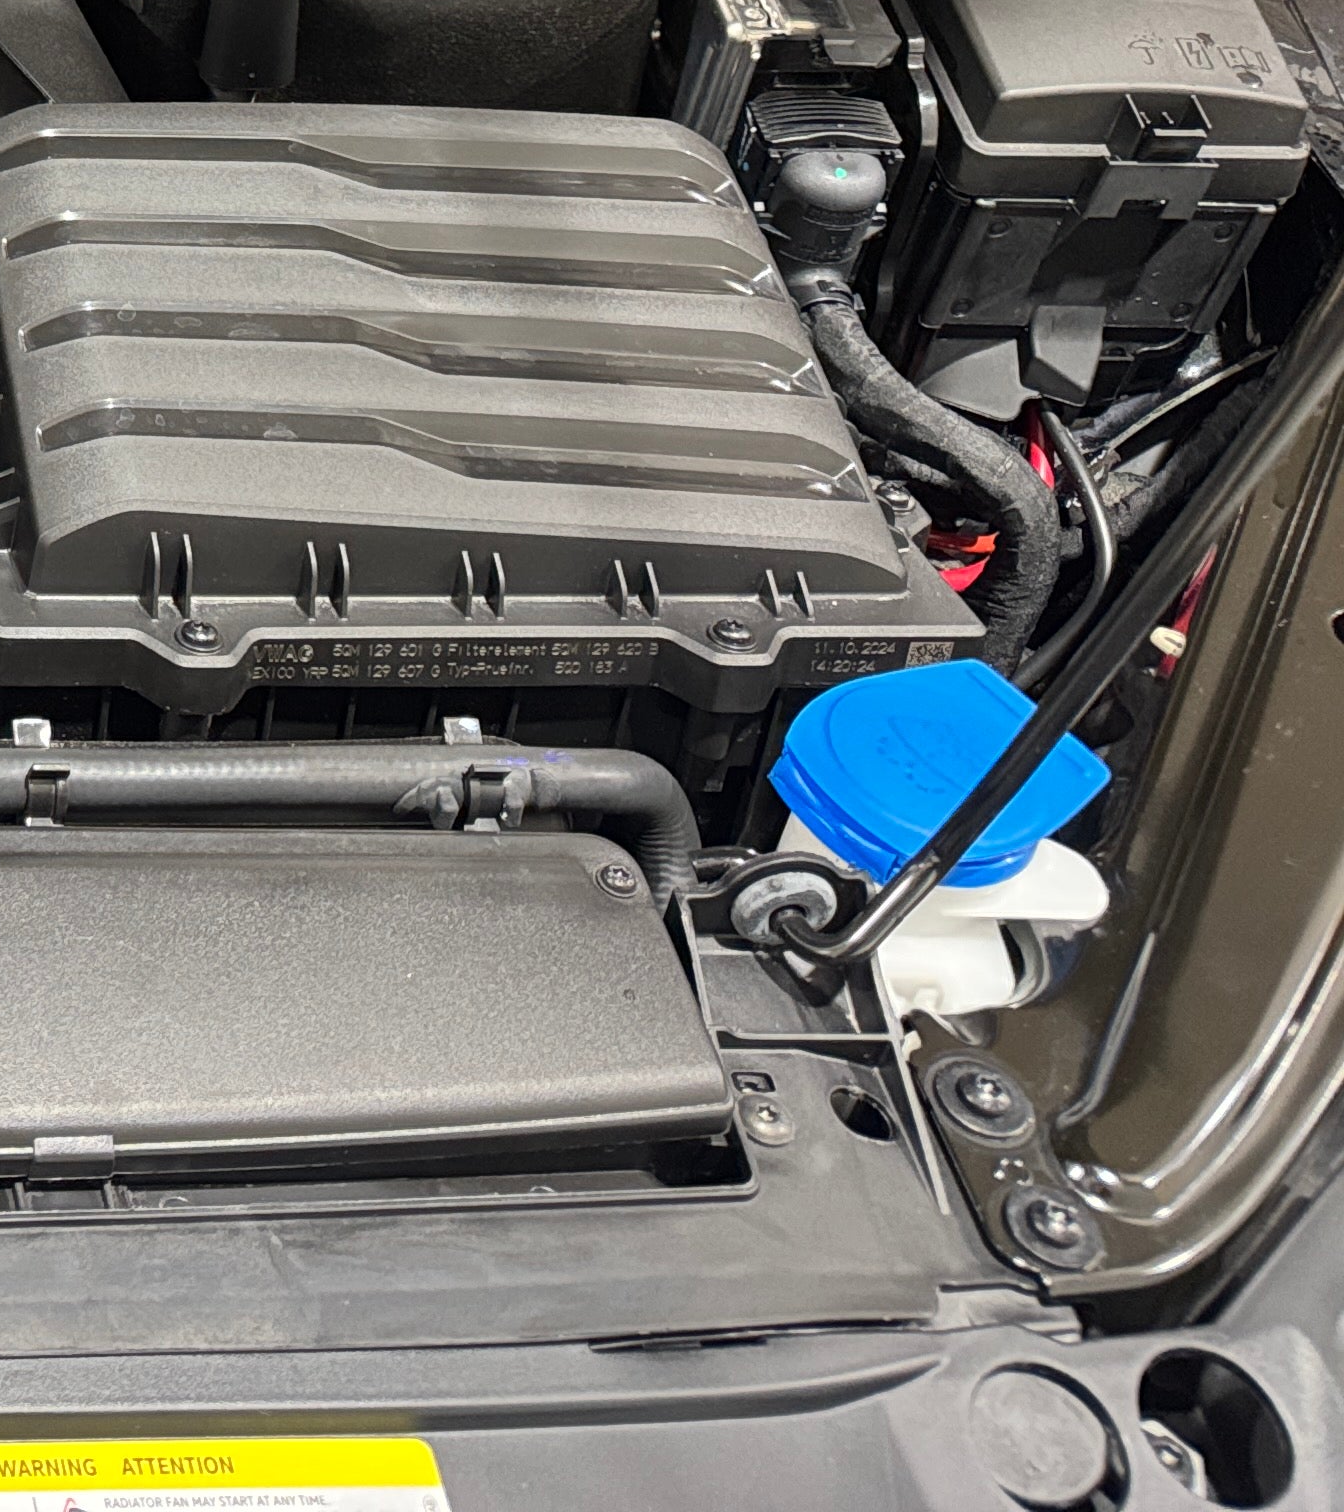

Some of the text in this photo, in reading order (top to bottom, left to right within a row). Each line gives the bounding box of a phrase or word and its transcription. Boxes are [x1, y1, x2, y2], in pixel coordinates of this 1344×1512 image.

[368, 643, 393, 657] 129
[447, 642, 547, 657] Filterelement
[587, 643, 610, 657] 129
[814, 641, 896, 655] 11.10.2024
[367, 664, 392, 678] 129
[121, 1456, 234, 1476] ATTENTION
[103, 1495, 162, 1509] RADIATOR
[164, 1495, 189, 1509] FAN
[191, 1495, 217, 1509] MAY
[219, 1495, 253, 1508] START
[255, 1495, 271, 1508] AT
[272, 1495, 297, 1508] ANY
